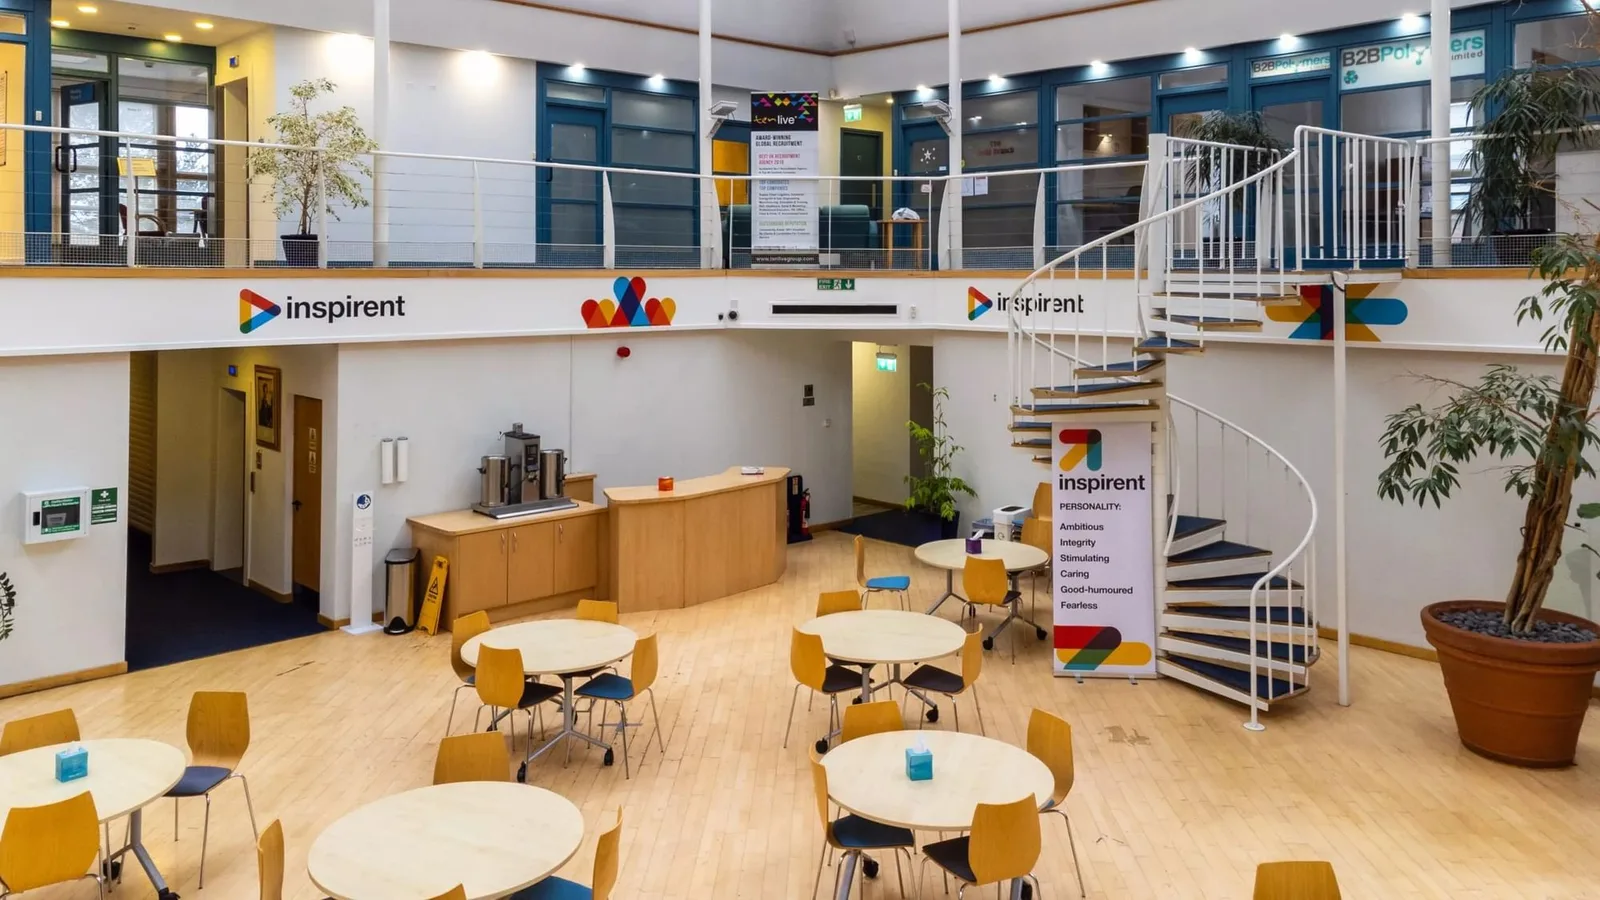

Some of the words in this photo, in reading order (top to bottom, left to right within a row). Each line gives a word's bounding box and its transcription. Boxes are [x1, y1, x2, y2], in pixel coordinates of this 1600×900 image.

[1451, 50, 1484, 61] imited
[777, 115, 796, 124] live
[286, 295, 406, 323] inspirent
[997, 292, 1084, 316] inspirent
[1059, 474, 1145, 494] inspirent
[1059, 503, 1122, 511] PERSONALITY:
[1059, 523, 1104, 531] Ambitious
[1060, 538, 1096, 548] Integrity
[1060, 554, 1110, 564] Stimulating
[1060, 569, 1089, 579] Caring
[1060, 585, 1133, 595] Good-humoured
[1060, 601, 1098, 610] Fearless
